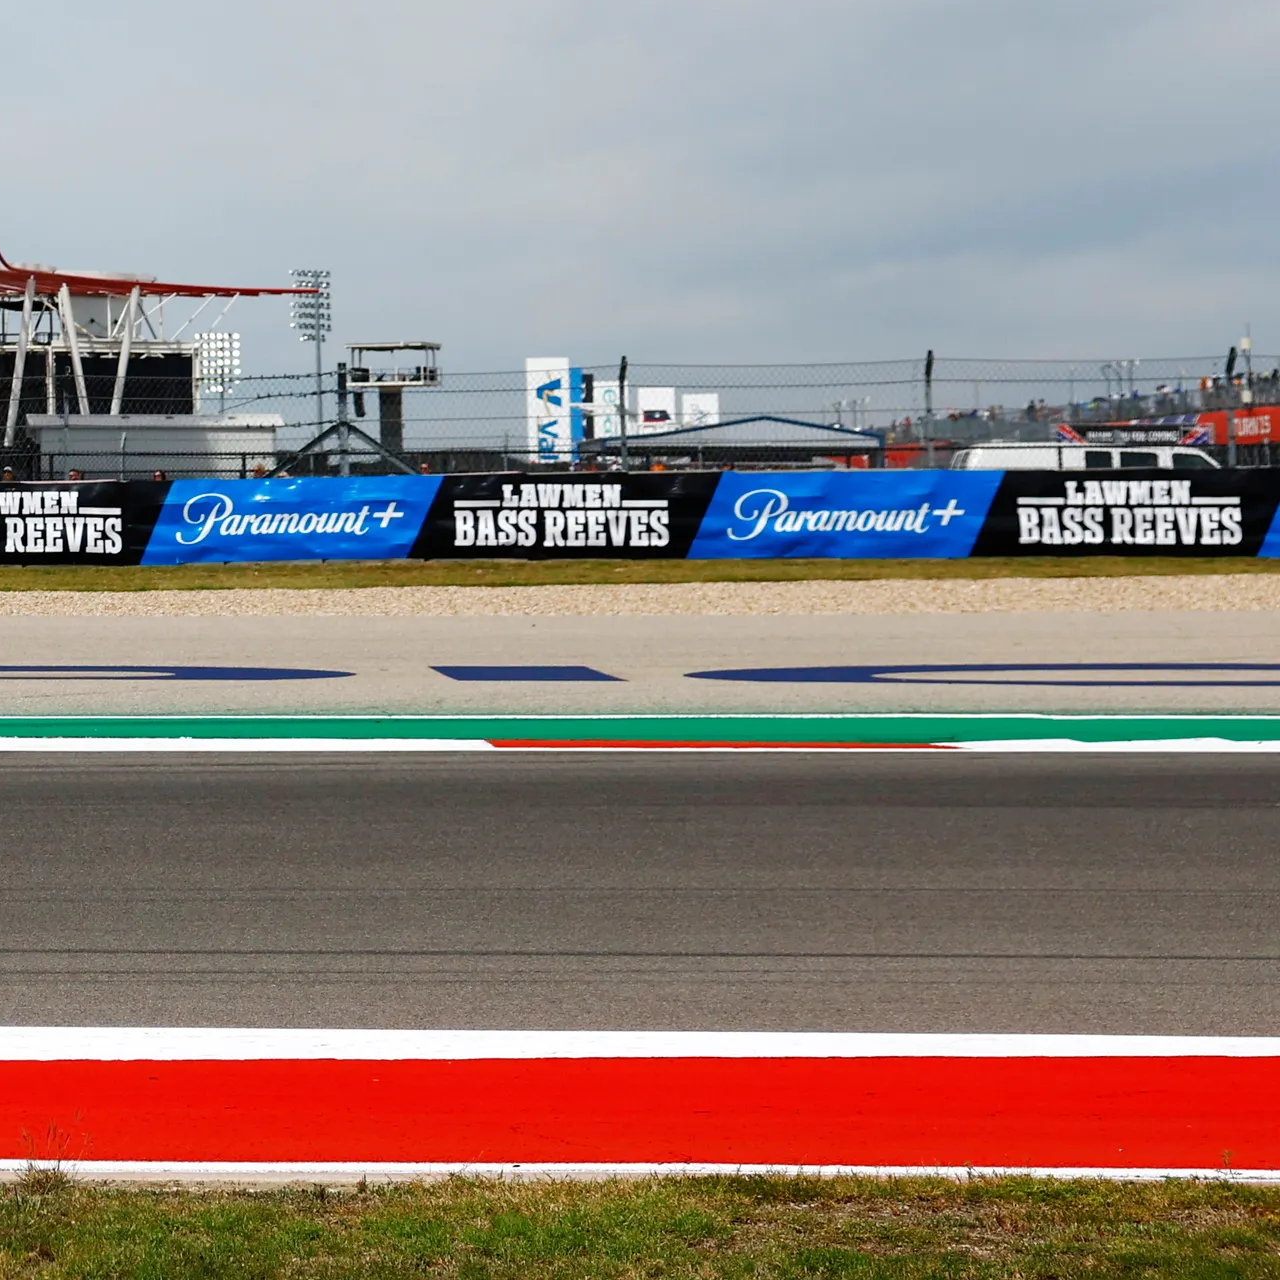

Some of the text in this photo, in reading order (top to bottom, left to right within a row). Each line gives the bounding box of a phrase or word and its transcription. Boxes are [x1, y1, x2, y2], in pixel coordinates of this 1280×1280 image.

[501, 483, 622, 508] LAWMEN
[1064, 480, 1192, 506] LAWMEN
[175, 493, 404, 545] Paramount+
[454, 509, 670, 547] BASS REEVES
[727, 489, 965, 541] Paramount+
[1017, 506, 1243, 545] BASS REEVES
[4, 516, 123, 555] REEVES
